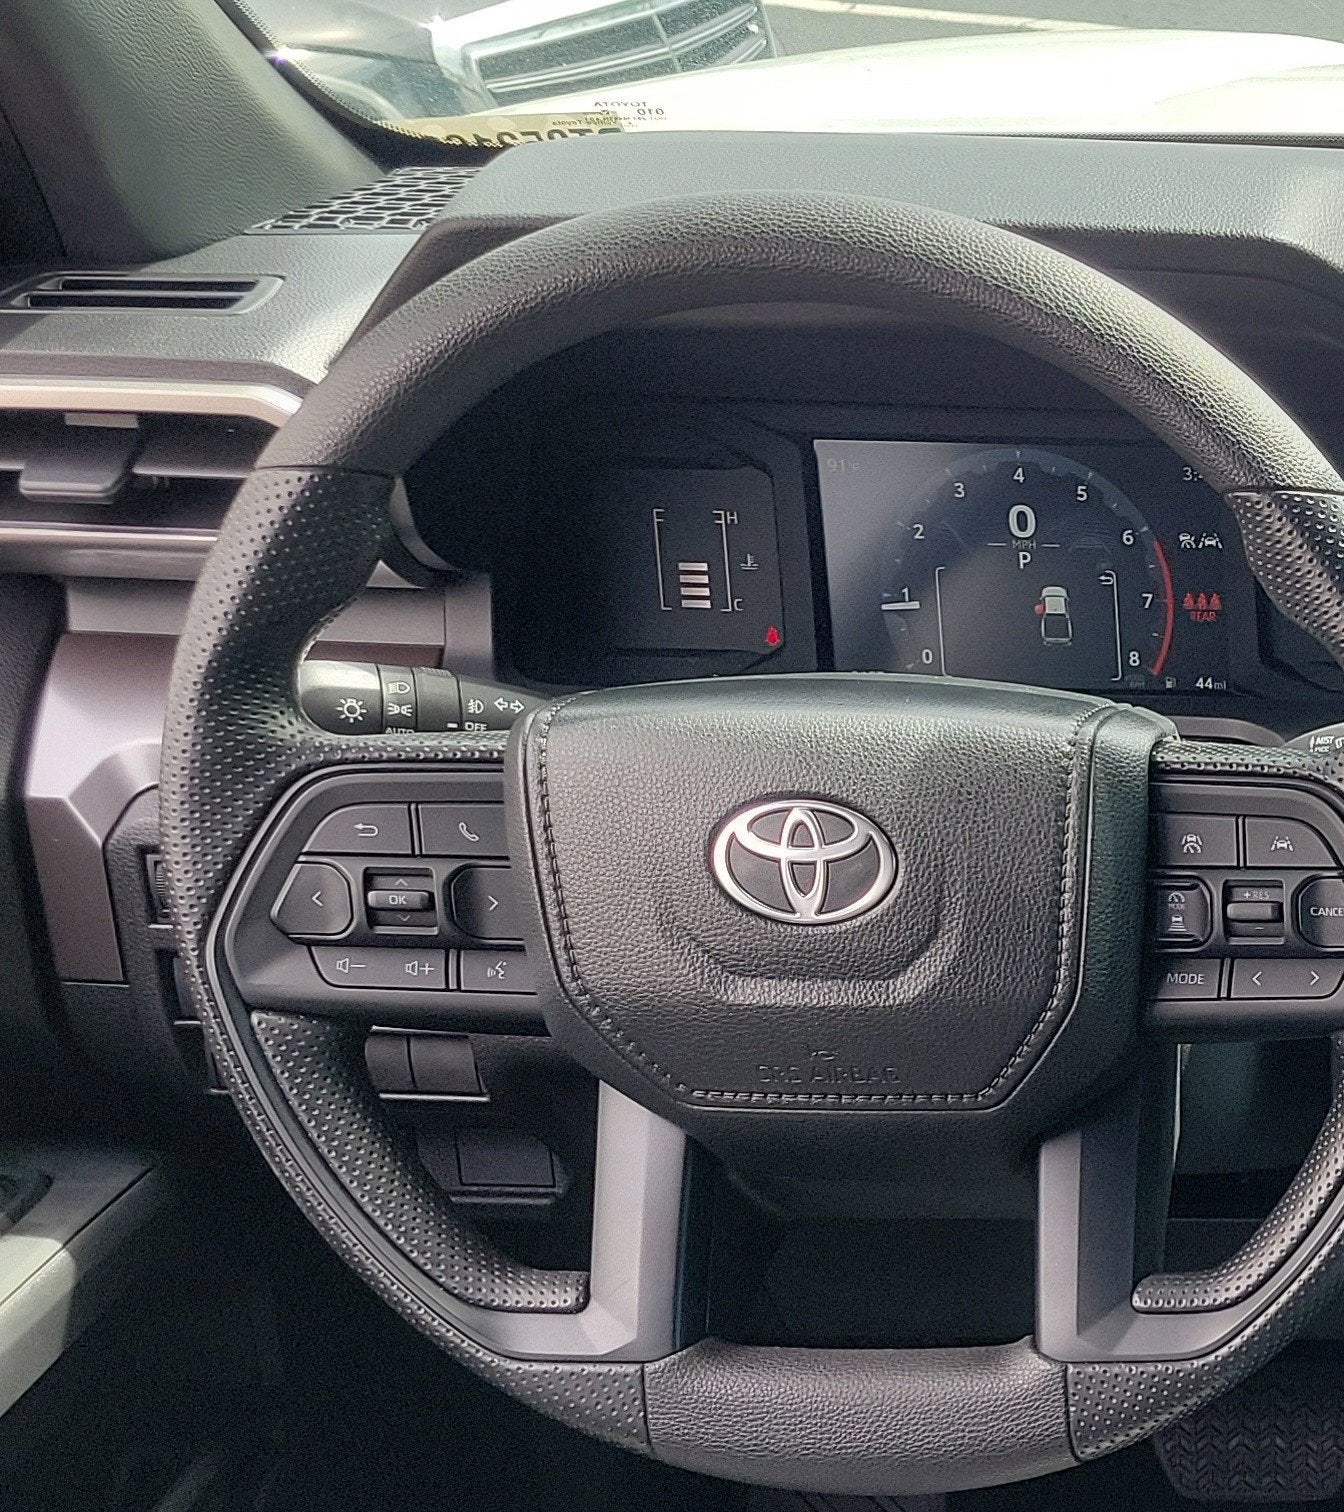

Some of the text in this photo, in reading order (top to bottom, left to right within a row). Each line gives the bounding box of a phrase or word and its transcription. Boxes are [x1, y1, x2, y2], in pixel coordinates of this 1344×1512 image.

[1013, 467, 1025, 483] 4
[954, 482, 965, 498] 3
[1076, 486, 1088, 502] 5
[1009, 504, 1036, 538] 0
[913, 524, 925, 540] 2
[1122, 529, 1134, 545] 6
[1019, 551, 1031, 569] P
[901, 587, 910, 602] 1
[1141, 593, 1153, 609] 7
[922, 649, 933, 664] 0
[1129, 651, 1140, 667] 8
[465, 722, 487, 732] OFF
[388, 895, 407, 905] OK
[1166, 972, 1205, 985] MODE
